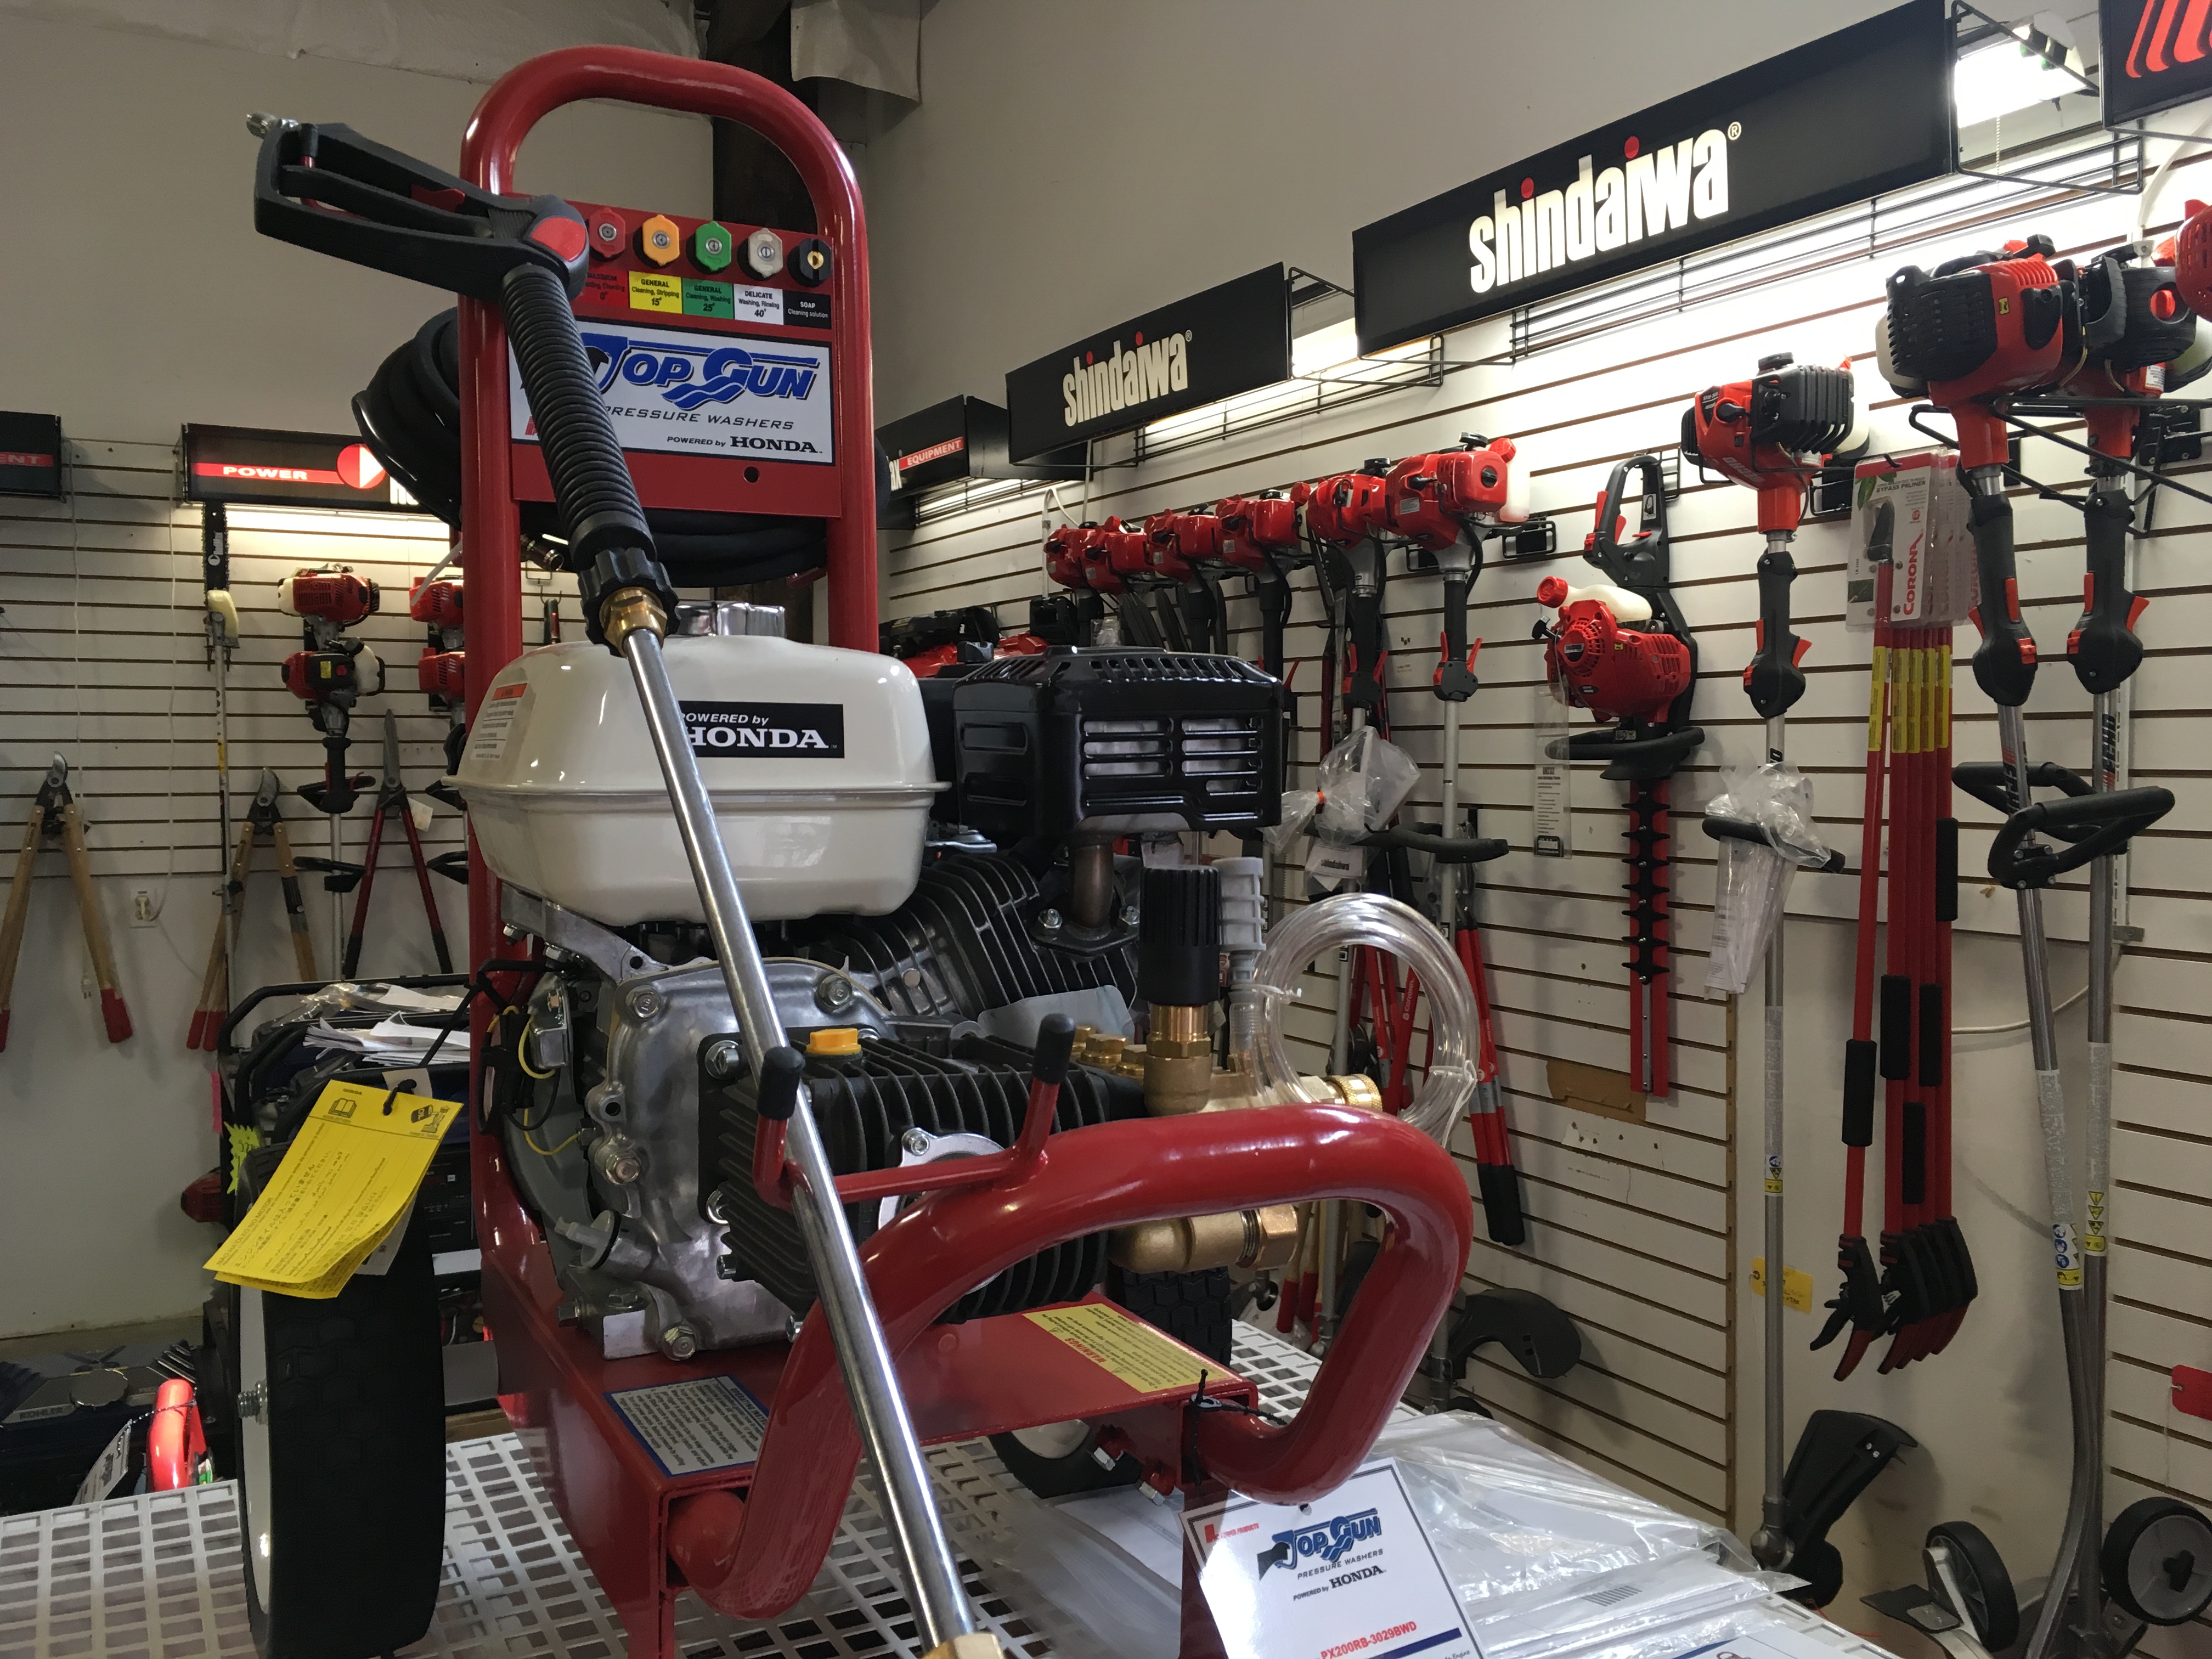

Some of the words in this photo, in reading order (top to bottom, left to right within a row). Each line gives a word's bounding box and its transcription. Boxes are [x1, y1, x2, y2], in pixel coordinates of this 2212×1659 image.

[641, 279, 670, 287] GENERAL
[693, 285, 722, 294] GENERAL
[656, 289, 679, 298] Stripping
[744, 290, 773, 300] DELICATE
[761, 301, 780, 309] Rinsing
[788, 308, 809, 318] Cleaning
[708, 414, 794, 430] WASHERS
[667, 436, 713, 446] POWERED
[715, 439, 726, 448] by
[730, 436, 819, 454] HONDA
[907, 439, 961, 466] EQUIPMENT
[223, 466, 307, 480] POWER
[1876, 484, 1900, 494] BYPASS
[1901, 480, 1926, 489] PRUNER
[1903, 532, 1924, 616] CORONA
[752, 715, 769, 726] by
[686, 726, 829, 749] HONDA
[255, 1197, 274, 1219] MOTOR
[1063, 1337, 1107, 1364] WARNINGS
[19, 1407, 64, 1420] KOHLER
[1297, 1561, 1342, 1580] PRESSURE
[1344, 1548, 1384, 1566] WASHERS
[1293, 1588, 1322, 1601] POWERED
[1329, 1565, 1385, 1589] HONDA
